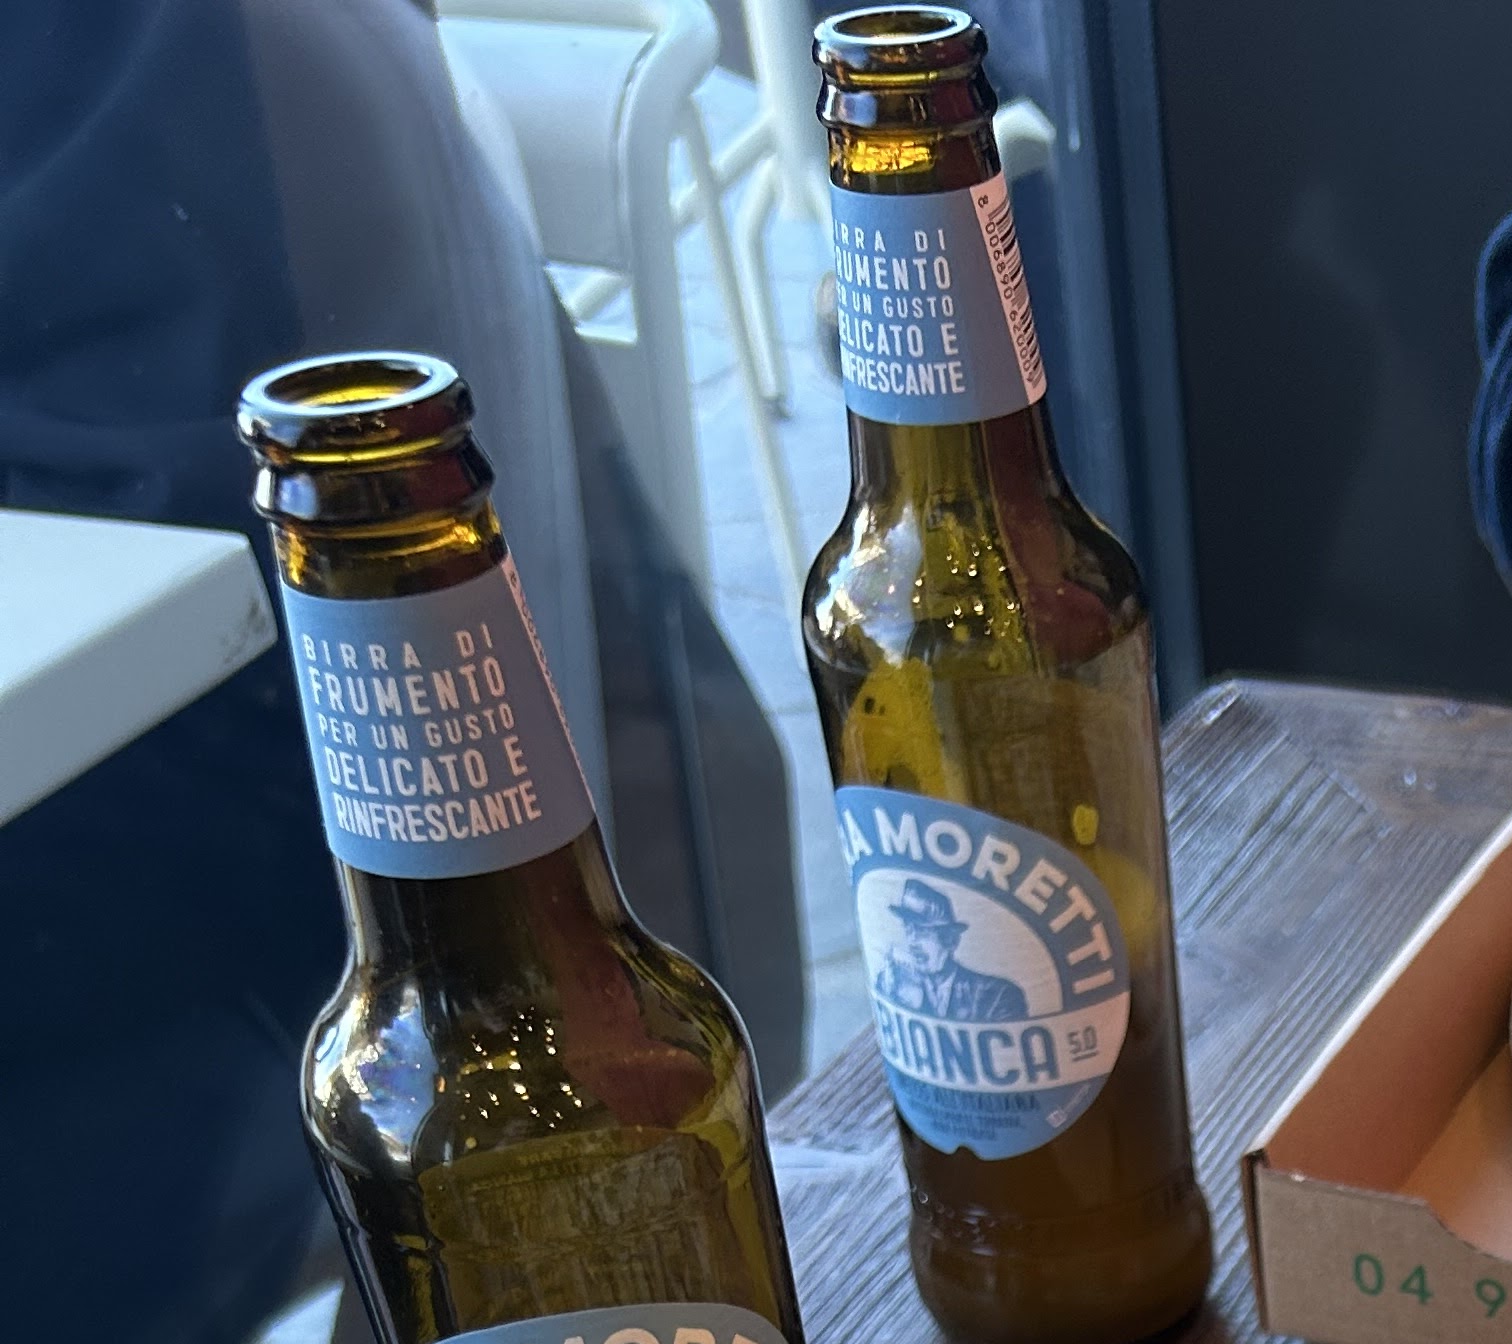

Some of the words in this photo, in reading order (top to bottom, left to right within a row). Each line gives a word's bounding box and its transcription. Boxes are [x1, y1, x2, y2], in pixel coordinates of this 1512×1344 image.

[834, 219, 886, 252] IRRA
[915, 229, 946, 252] DI
[978, 194, 989, 208] 8
[985, 221, 1013, 300] 006890
[835, 246, 951, 291] RUMENTO
[852, 291, 873, 315] UN
[882, 295, 954, 319] GUSTO
[838, 308, 923, 357] ELICATO
[941, 322, 959, 356] E
[302, 633, 421, 671] BIRRA
[455, 624, 493, 658] DI
[310, 656, 505, 717] FRUMENTO
[317, 713, 358, 748] PER
[372, 726, 409, 751] UN
[425, 704, 514, 748] GUSTO
[325, 748, 488, 797] DELICATO
[504, 735, 528, 776] E
[333, 781, 542, 843] RINFRESCANTE
[873, 807, 1115, 994] MORETTI
[1352, 1253, 1434, 1307] 04
